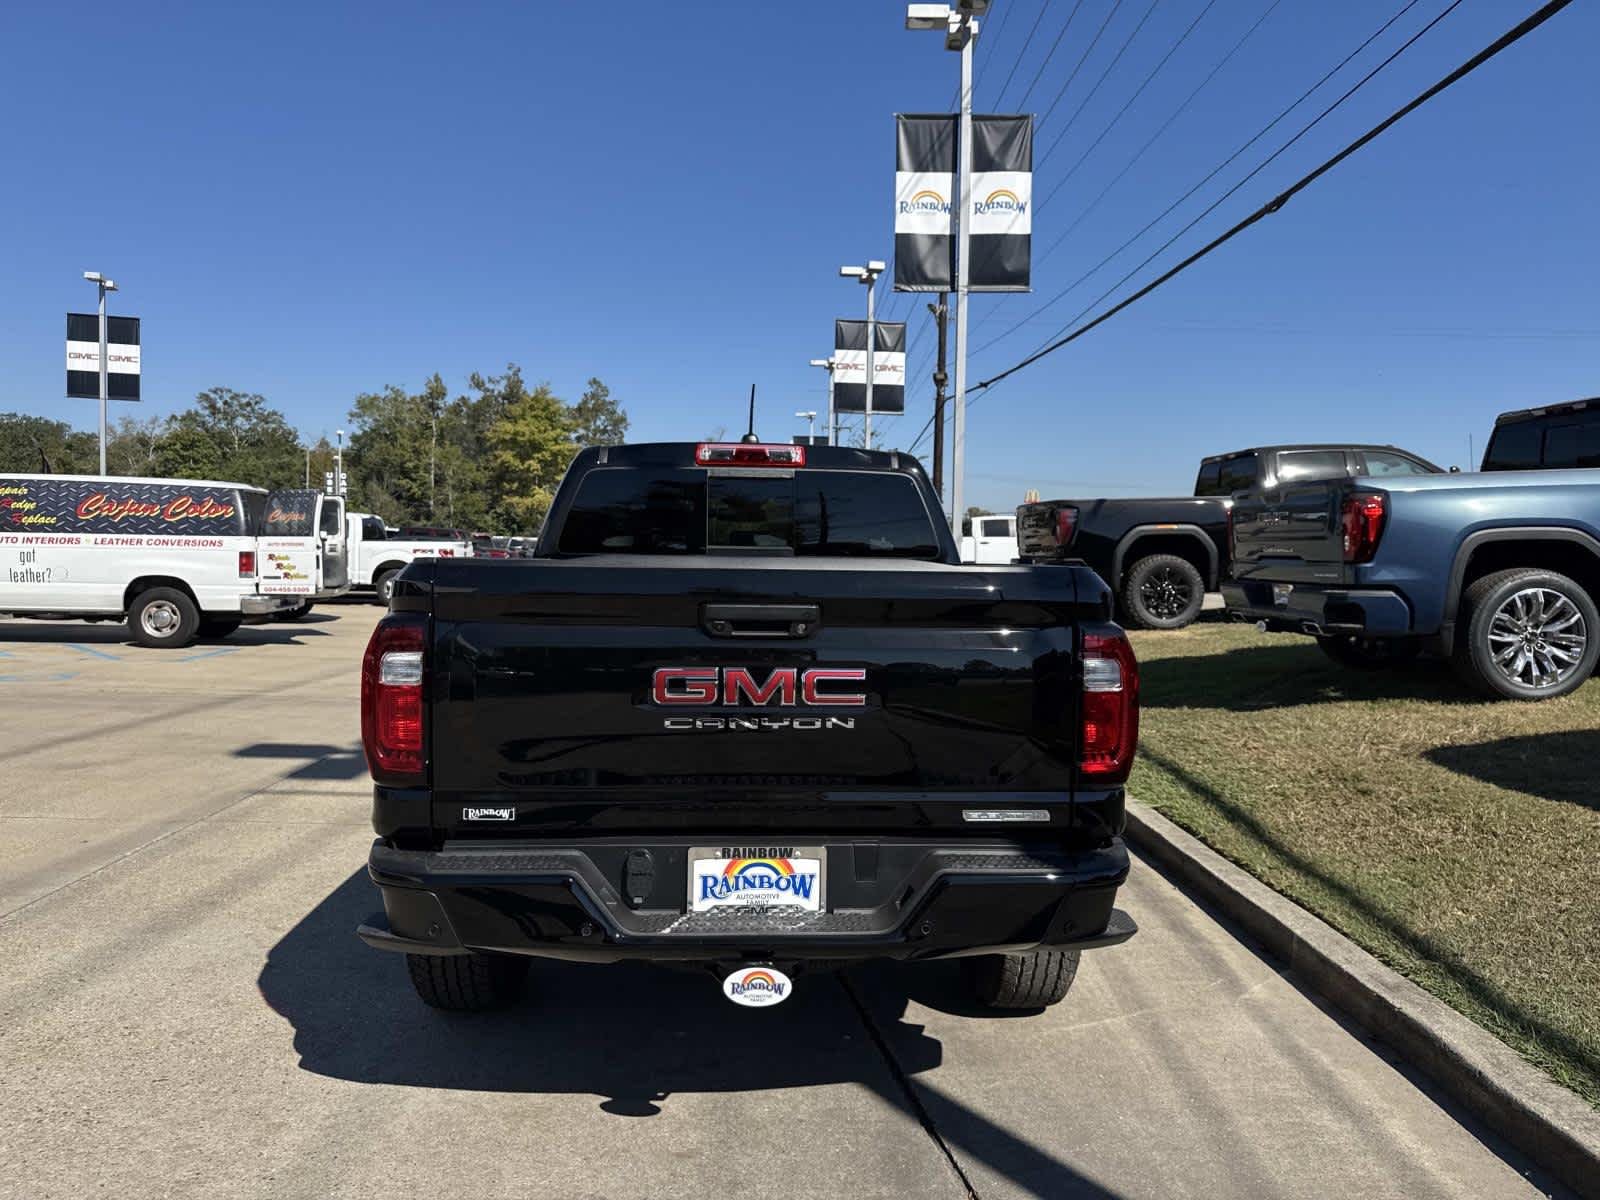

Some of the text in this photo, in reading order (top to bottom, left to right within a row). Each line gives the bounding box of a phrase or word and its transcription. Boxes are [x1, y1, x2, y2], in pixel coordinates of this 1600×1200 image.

[900, 200, 953, 216] RAINBOW
[973, 200, 1028, 216] RAINBOW
[68, 352, 100, 361] GMC
[108, 354, 139, 363] GMC
[836, 362, 865, 371] GMC
[874, 364, 904, 373] GMC
[76, 492, 235, 523] Cajun Color
[22, 536, 81, 546] INTERIORS
[94, 537, 143, 547] LEATHER
[146, 538, 224, 548] CONVERSIONS
[19, 547, 36, 566] got
[9, 567, 52, 583] leather?
[652, 667, 866, 706] GMC
[664, 717, 855, 730] CANYON
[468, 808, 510, 819] RAINBOW
[721, 847, 794, 859] RAINBOW
[699, 873, 816, 901] RAINBOW
[731, 982, 785, 997] RAINBOW
